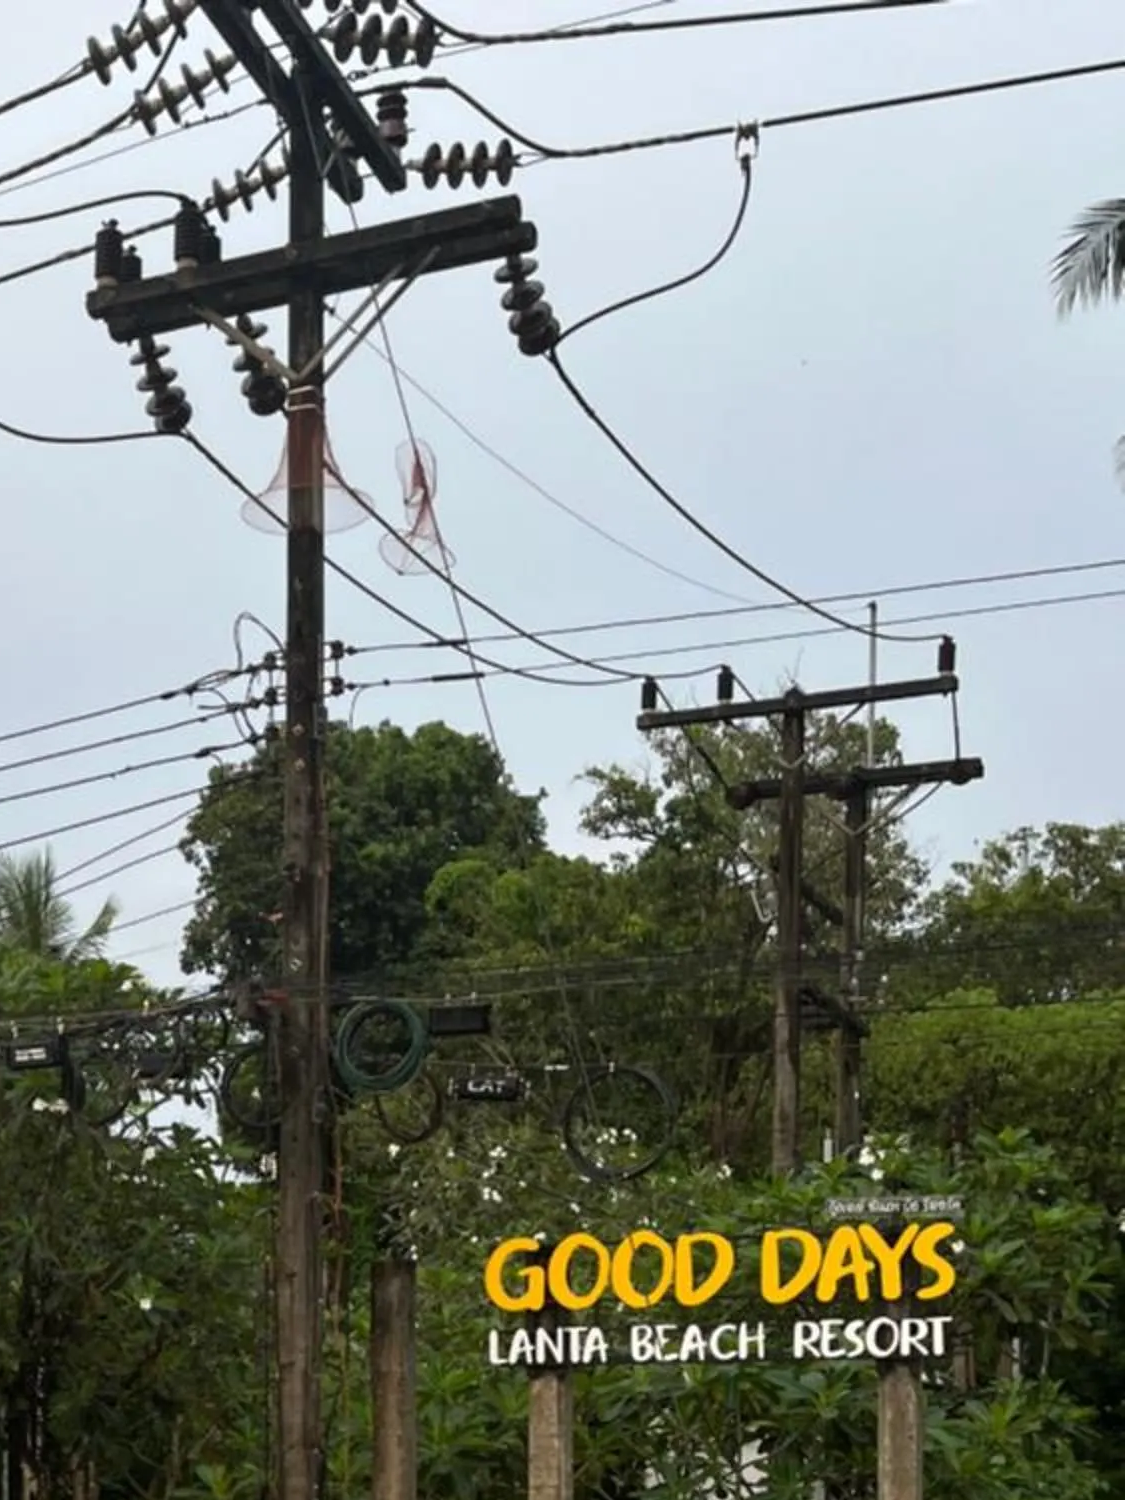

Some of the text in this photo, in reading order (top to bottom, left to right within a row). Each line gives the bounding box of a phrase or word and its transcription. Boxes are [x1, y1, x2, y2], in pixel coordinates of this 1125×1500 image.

[484, 1222, 956, 1312] GOOD DAYS
[489, 1316, 953, 1365] LANTA BEACH RESORT
